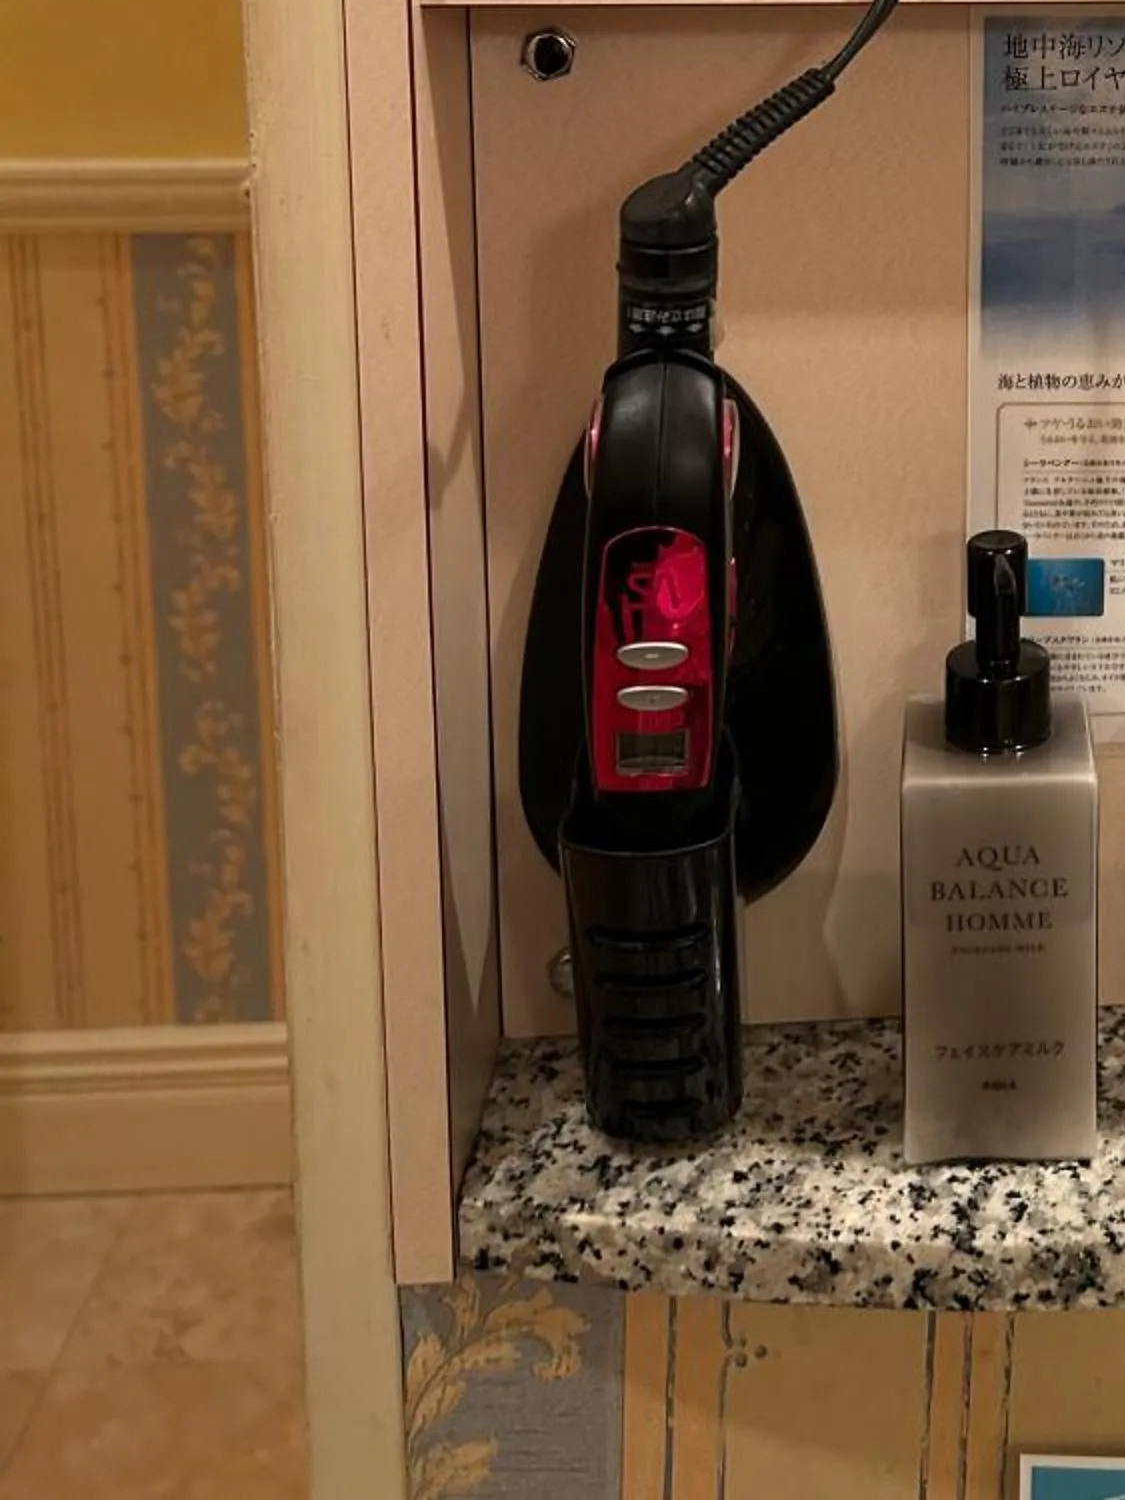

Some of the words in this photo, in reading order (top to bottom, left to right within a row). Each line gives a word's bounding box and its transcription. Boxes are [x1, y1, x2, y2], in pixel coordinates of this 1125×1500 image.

[956, 845, 1041, 871] AQUA
[931, 877, 1069, 902] BALANCE
[945, 911, 1053, 933] HOMME
